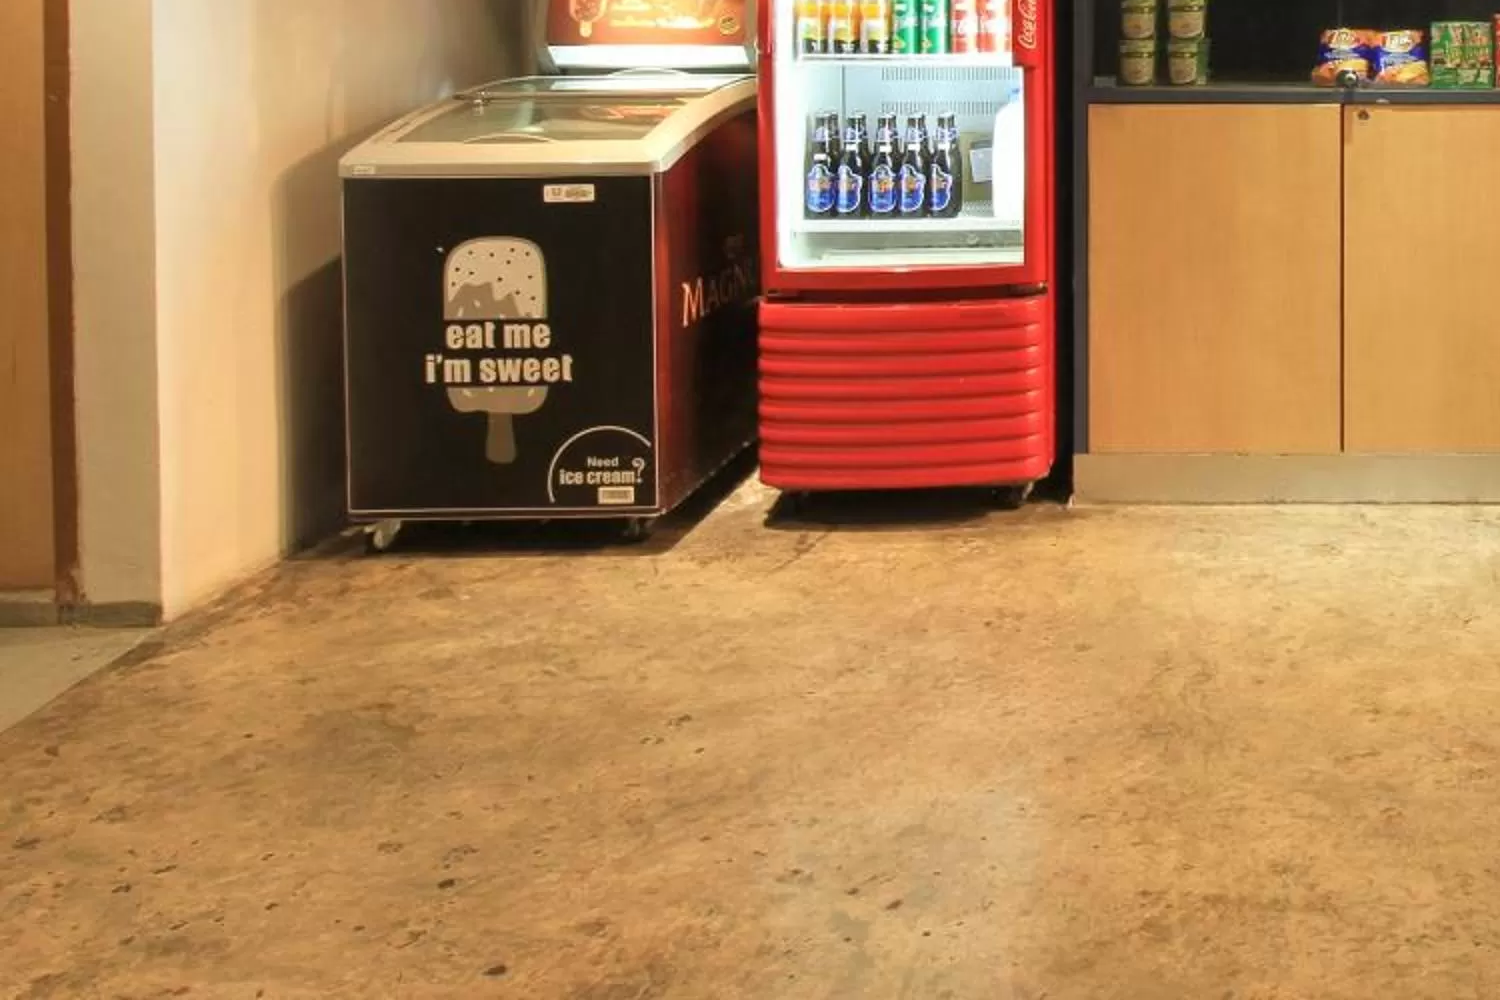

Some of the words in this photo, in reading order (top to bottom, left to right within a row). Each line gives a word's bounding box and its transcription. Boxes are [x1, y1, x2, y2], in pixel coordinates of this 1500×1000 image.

[445, 321, 496, 350] eat
[503, 323, 552, 349] me
[425, 353, 471, 384] i'm
[479, 354, 573, 383] sweet
[587, 456, 619, 467] Need
[559, 468, 584, 485] ice
